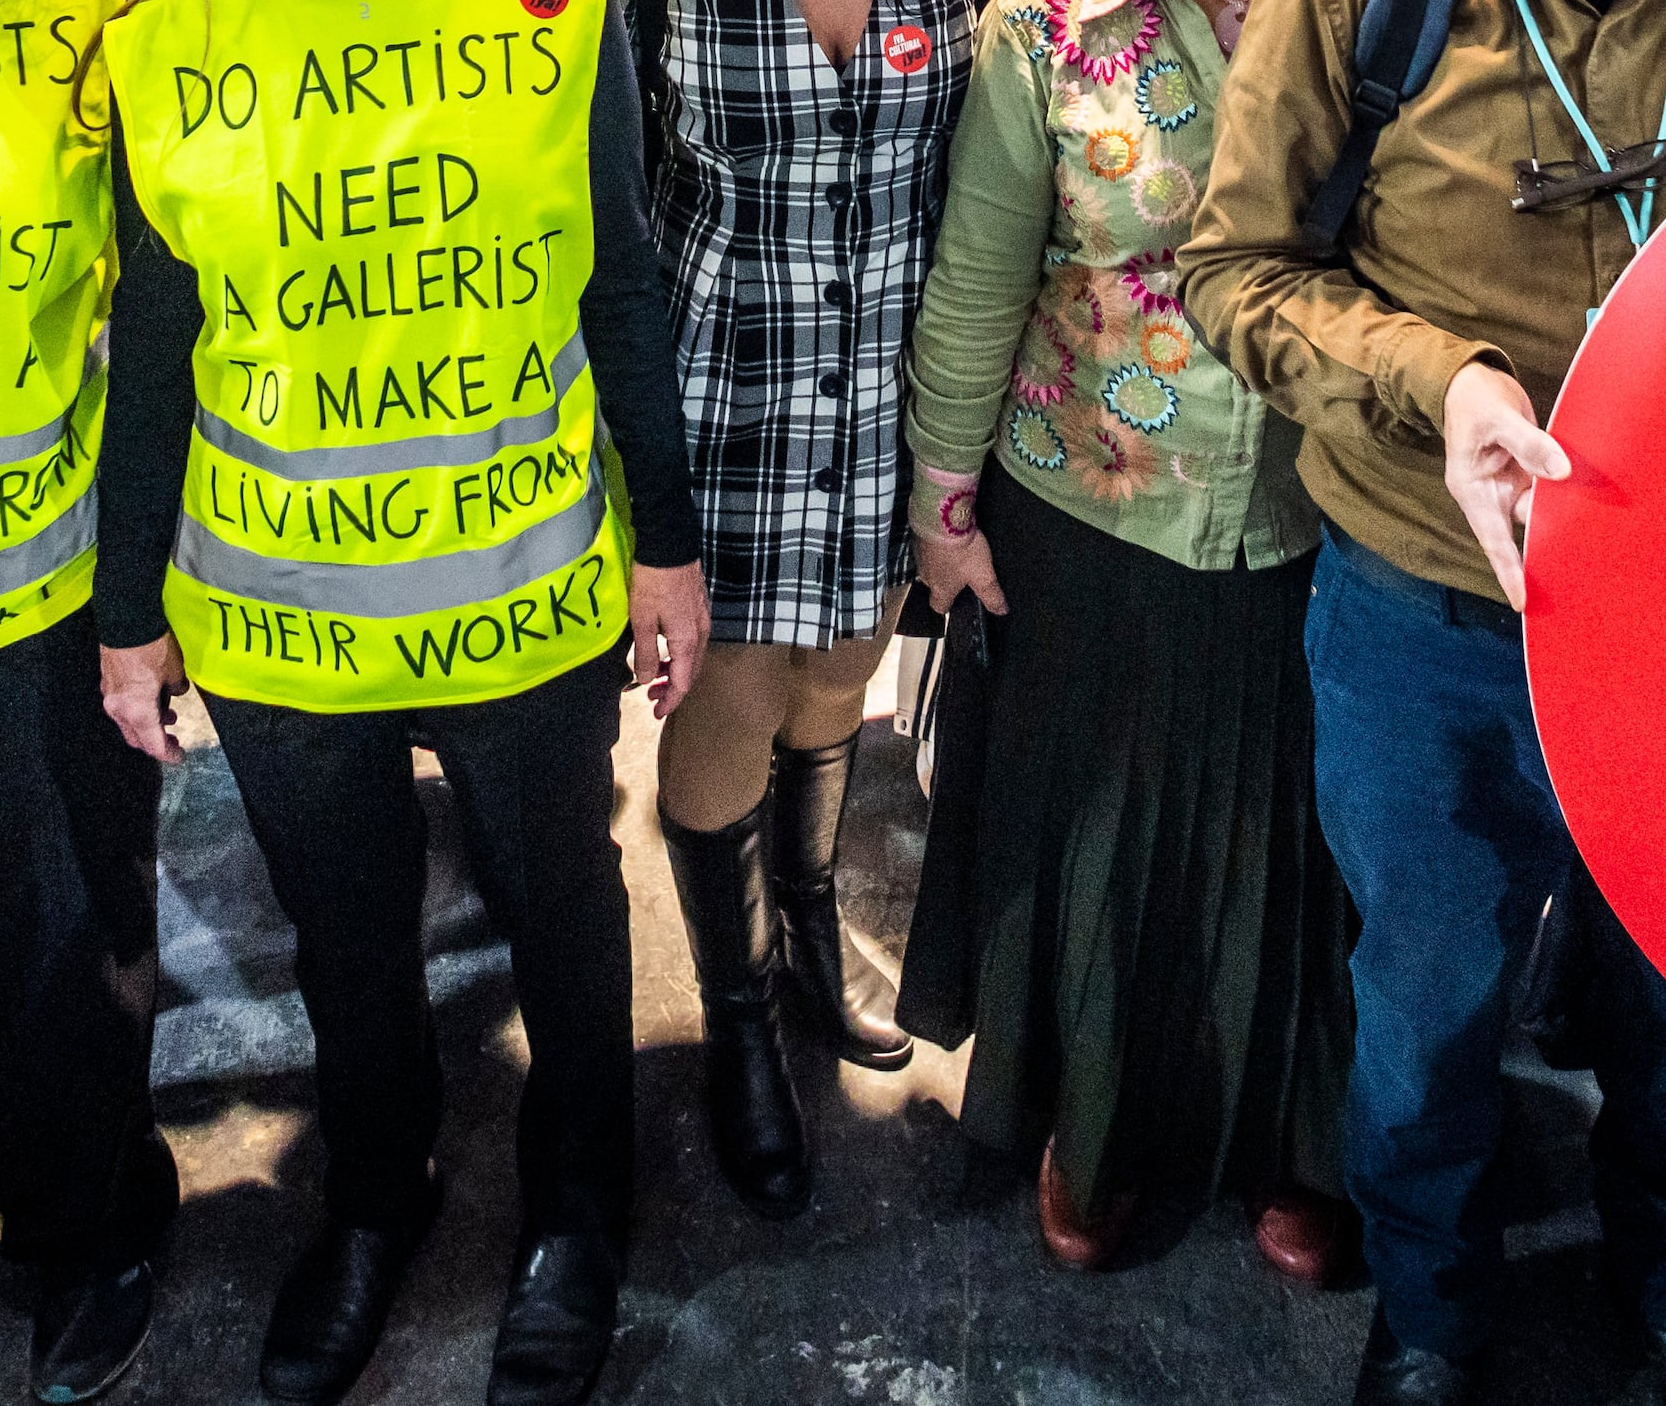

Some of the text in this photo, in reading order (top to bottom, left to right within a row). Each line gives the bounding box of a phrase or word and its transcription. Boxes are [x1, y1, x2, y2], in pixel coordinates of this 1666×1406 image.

[888, 37, 922, 58] CULTURAL
[893, 33, 906, 45] IVA
[174, 61, 258, 139] DO
[275, 152, 480, 247] NEED
[224, 273, 257, 332] A
[228, 340, 552, 429] TO MAKE A
[454, 441, 583, 536] FROM
[395, 552, 605, 679] WORK?
